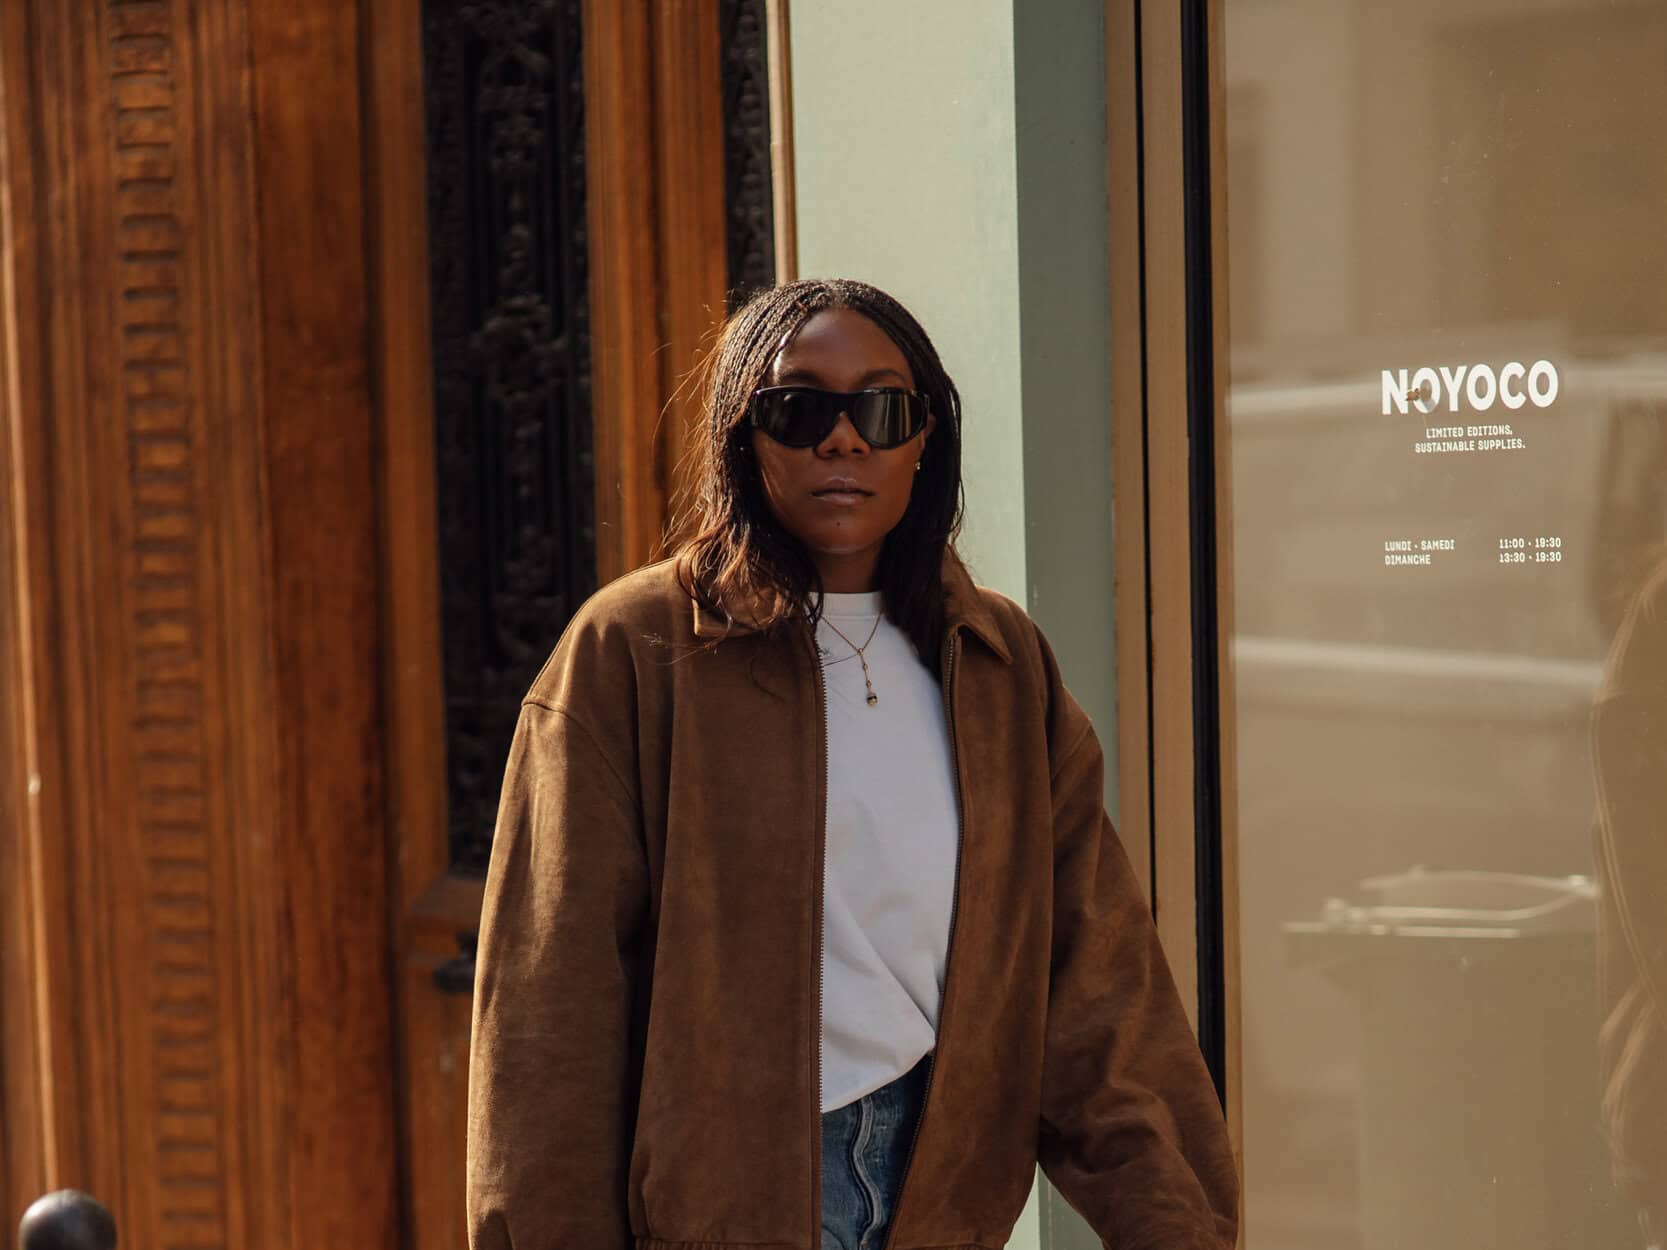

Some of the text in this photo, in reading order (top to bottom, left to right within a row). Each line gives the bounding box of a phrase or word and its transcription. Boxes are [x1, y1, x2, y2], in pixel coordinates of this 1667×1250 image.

[1381, 360, 1559, 415] NOYOCO
[1425, 427, 1464, 439] LIMITED
[1415, 438, 1526, 453] SUSTAINABLE SUPPLIES.
[1384, 541, 1412, 552] LUNDI
[1421, 539, 1455, 550] SAMEDI
[1499, 538, 1525, 549] 11:00
[1384, 554, 1431, 565] DIMANCHE
[1499, 552, 1526, 563] 13:30
